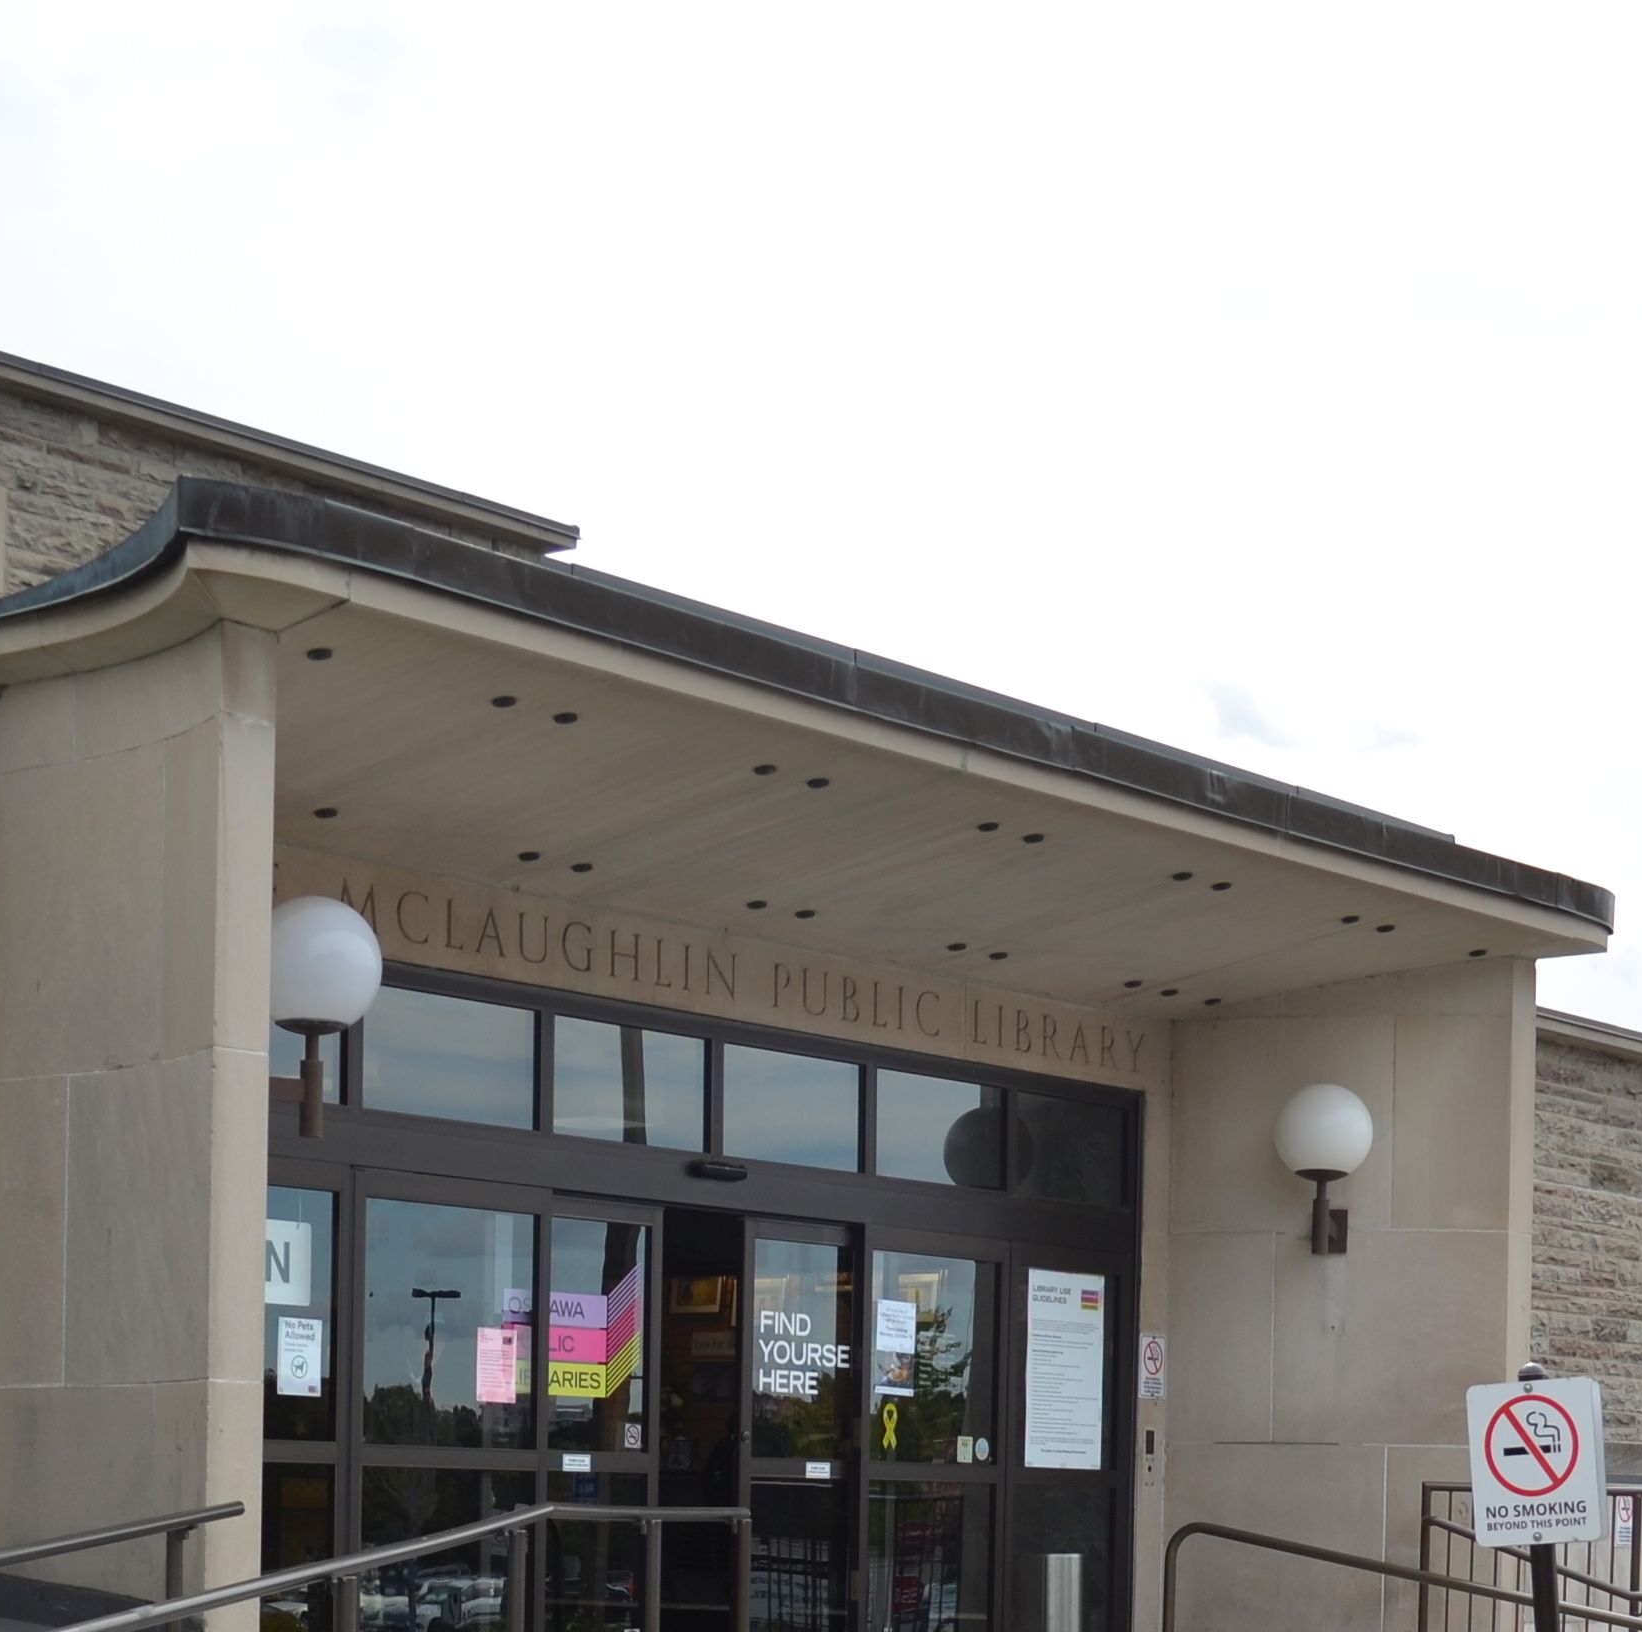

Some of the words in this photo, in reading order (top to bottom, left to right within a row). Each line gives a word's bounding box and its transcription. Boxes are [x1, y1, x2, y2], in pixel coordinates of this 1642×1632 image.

[339, 877, 738, 999] MCLAUGHLIN
[771, 961, 940, 1038] PUBLIC
[972, 999, 1146, 1073] LIBRARY
[1032, 1285, 1058, 1293] LIBRARY
[508, 1295, 585, 1319] OSAWA
[284, 1319, 296, 1329] No
[297, 1321, 314, 1331] Pets
[760, 1310, 812, 1337] FIND
[284, 1330, 315, 1341] Allowed
[758, 1368, 819, 1395] HERE
[1485, 1505, 1509, 1519] NO
[1513, 1500, 1587, 1518] SMOKING
[1487, 1520, 1528, 1532] BEYOND
[1530, 1518, 1553, 1529] THIS
[1555, 1516, 1587, 1528] POINT
